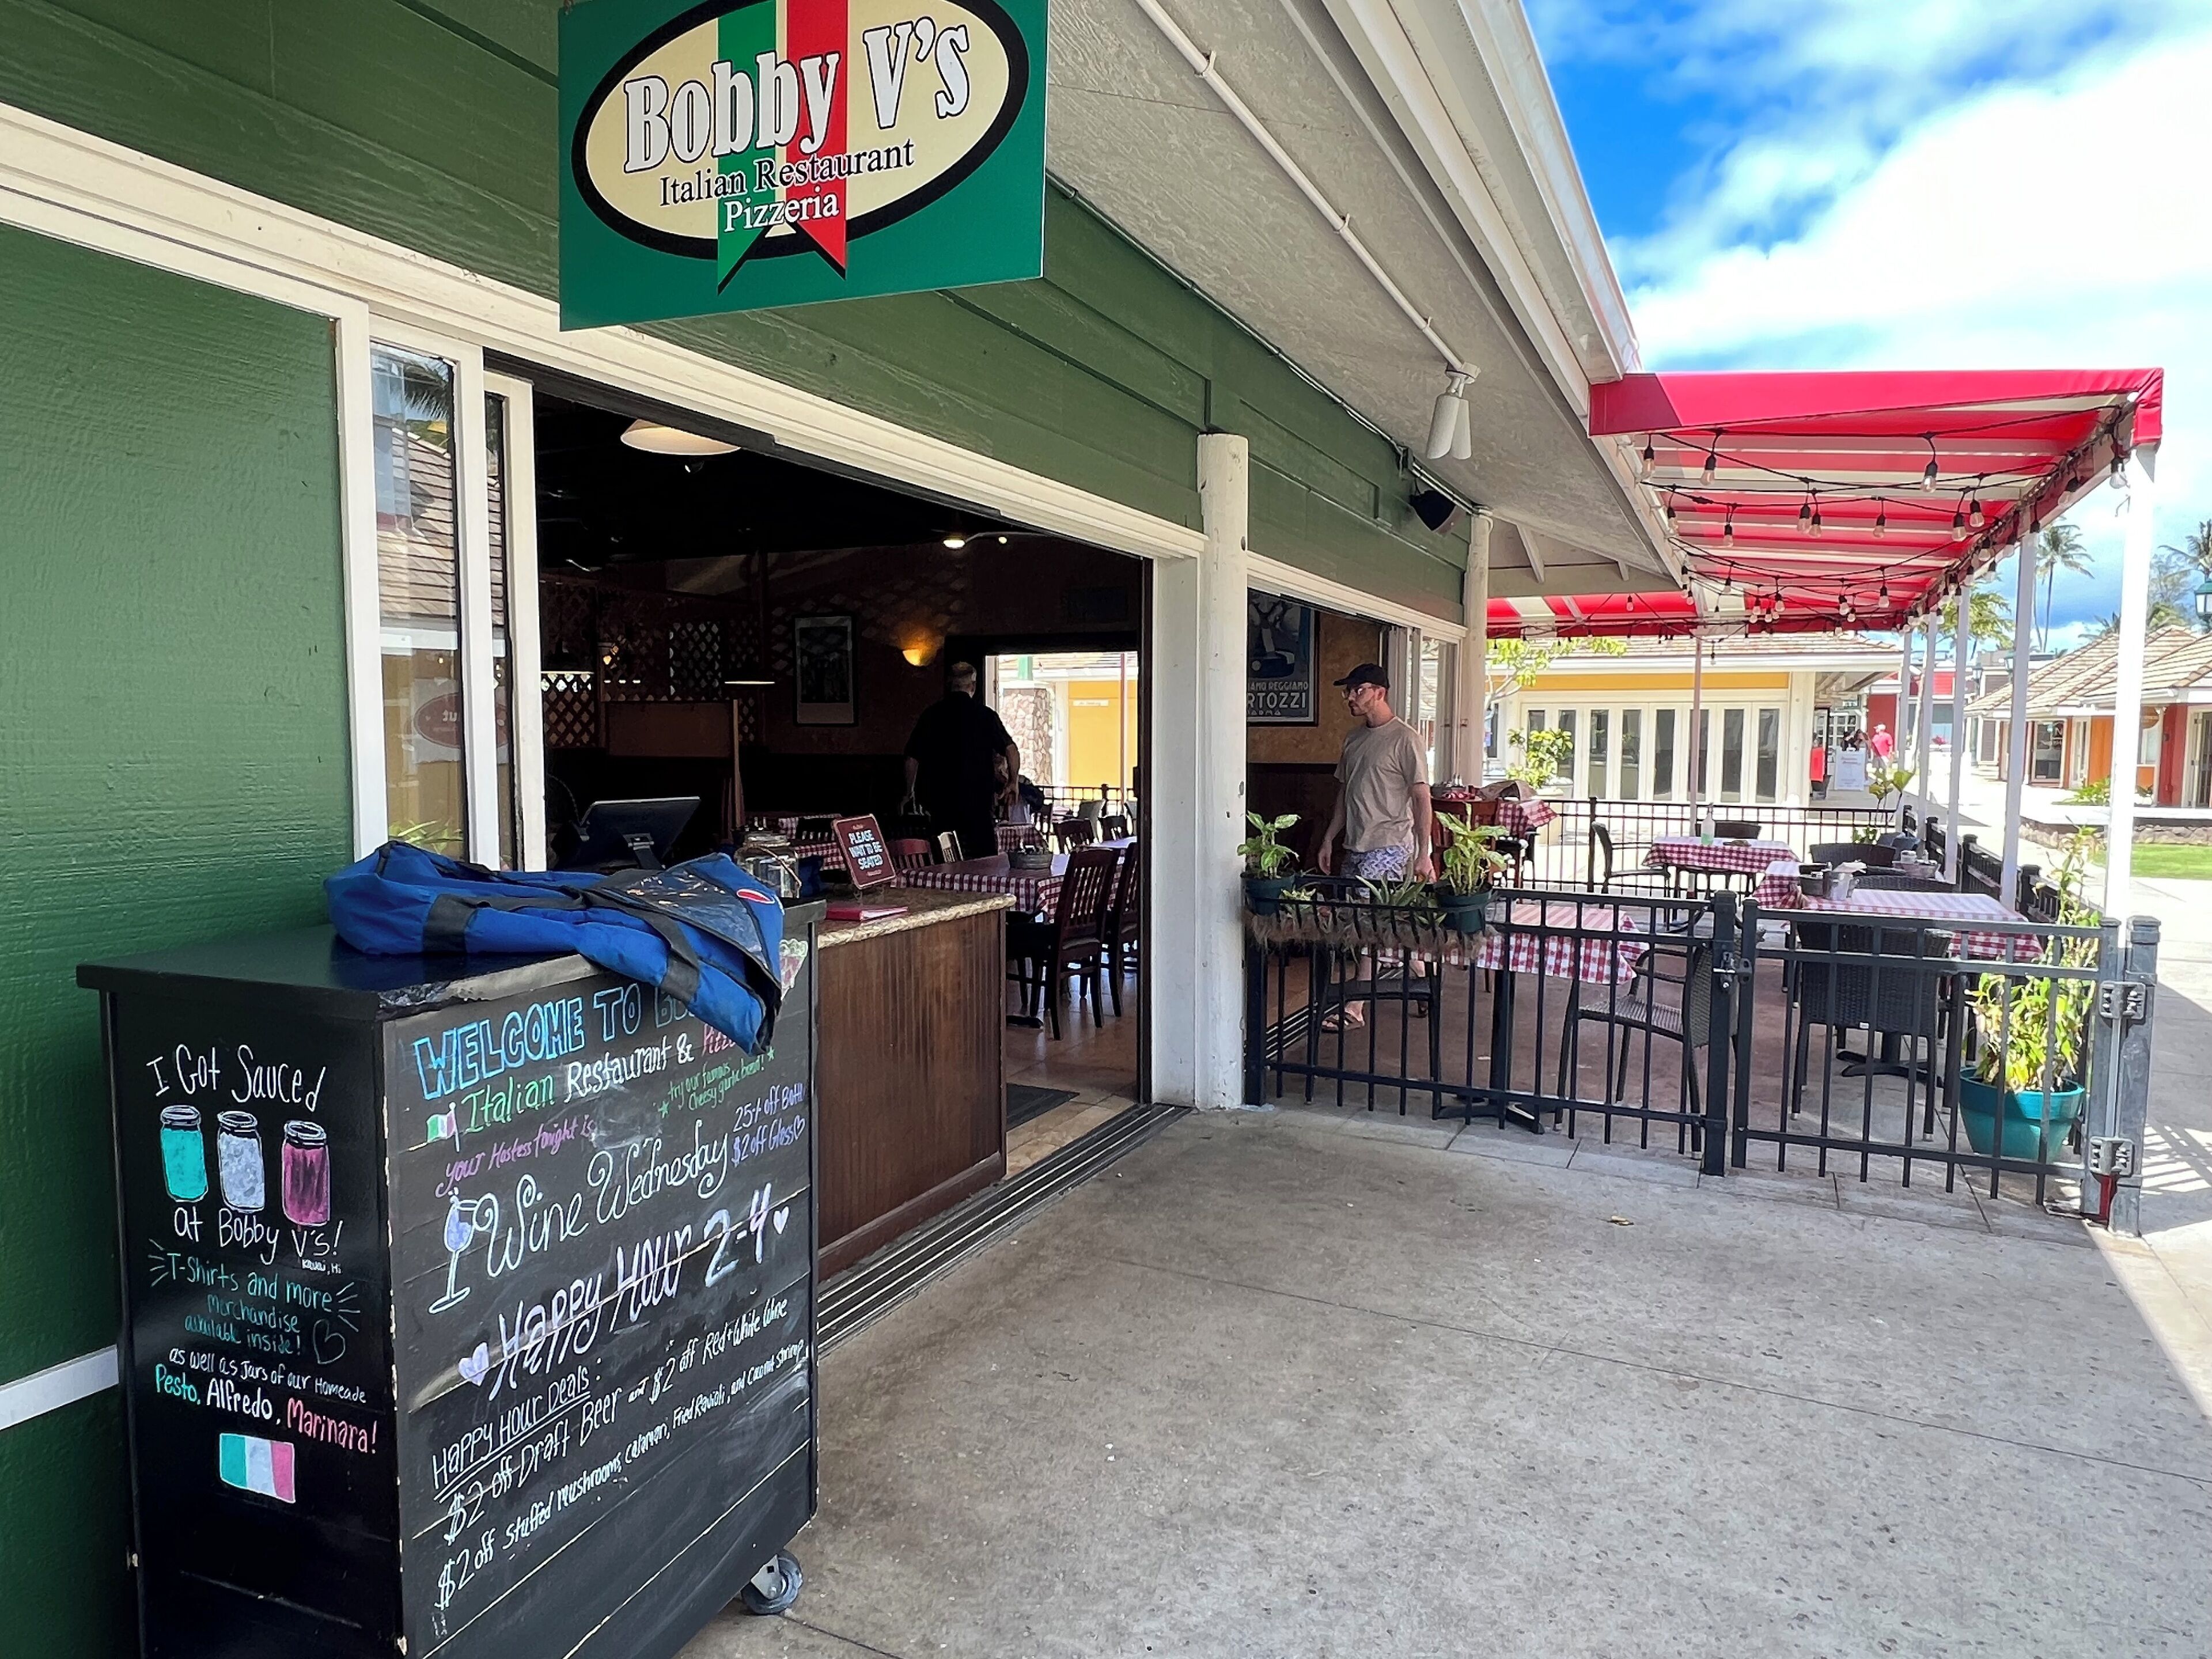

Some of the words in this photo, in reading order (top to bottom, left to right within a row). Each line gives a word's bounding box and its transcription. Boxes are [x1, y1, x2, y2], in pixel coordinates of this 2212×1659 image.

[624, 51, 840, 173] Bobby
[863, 17, 970, 130] V's
[660, 167, 747, 206] Italian
[755, 138, 915, 194] Restaurant
[724, 186, 839, 233] Pizzeria
[1247, 692, 1306, 709] RTOZZI
[849, 830, 874, 844] PLEASE
[858, 854, 883, 870] SEATED
[872, 841, 883, 853] BE
[412, 997, 585, 1100] WELCOME
[593, 983, 641, 1042] TO
[146, 1056, 170, 1096] I
[176, 1044, 221, 1094] Got
[231, 1044, 326, 1112] Sauced
[461, 1073, 555, 1132] Italian
[563, 1035, 673, 1104] Restaurant
[676, 1033, 695, 1064] &
[685, 1071, 702, 1093] our
[764, 1084, 781, 1116] off
[488, 1138, 532, 1171] Hostess
[731, 1133, 749, 1168] $2
[751, 1124, 768, 1157] off
[768, 1118, 794, 1151] Glass
[472, 1174, 589, 1277] Wine
[586, 1119, 728, 1224] Wednesday
[219, 1207, 279, 1264] Bobby
[247, 1271, 278, 1300] and
[287, 1280, 333, 1312] more
[489, 1272, 602, 1401] Happy
[703, 1183, 772, 1288] 2-4
[169, 1347, 185, 1365] as
[190, 1351, 215, 1373] well
[219, 1356, 238, 1377] as
[271, 1363, 286, 1385] of
[287, 1372, 311, 1390] our
[287, 1397, 377, 1454] Marinara!
[444, 1480, 485, 1546] $2
[491, 1455, 513, 1499] off
[518, 1418, 571, 1488] Draft
[579, 1388, 623, 1447] Beer
[649, 1358, 676, 1405] $2
[679, 1338, 699, 1373] off
[763, 1297, 788, 1328] Wine
[434, 1549, 475, 1611] $2
[474, 1528, 496, 1570] off
[672, 1397, 695, 1429] Fried
[731, 1370, 746, 1395] and
